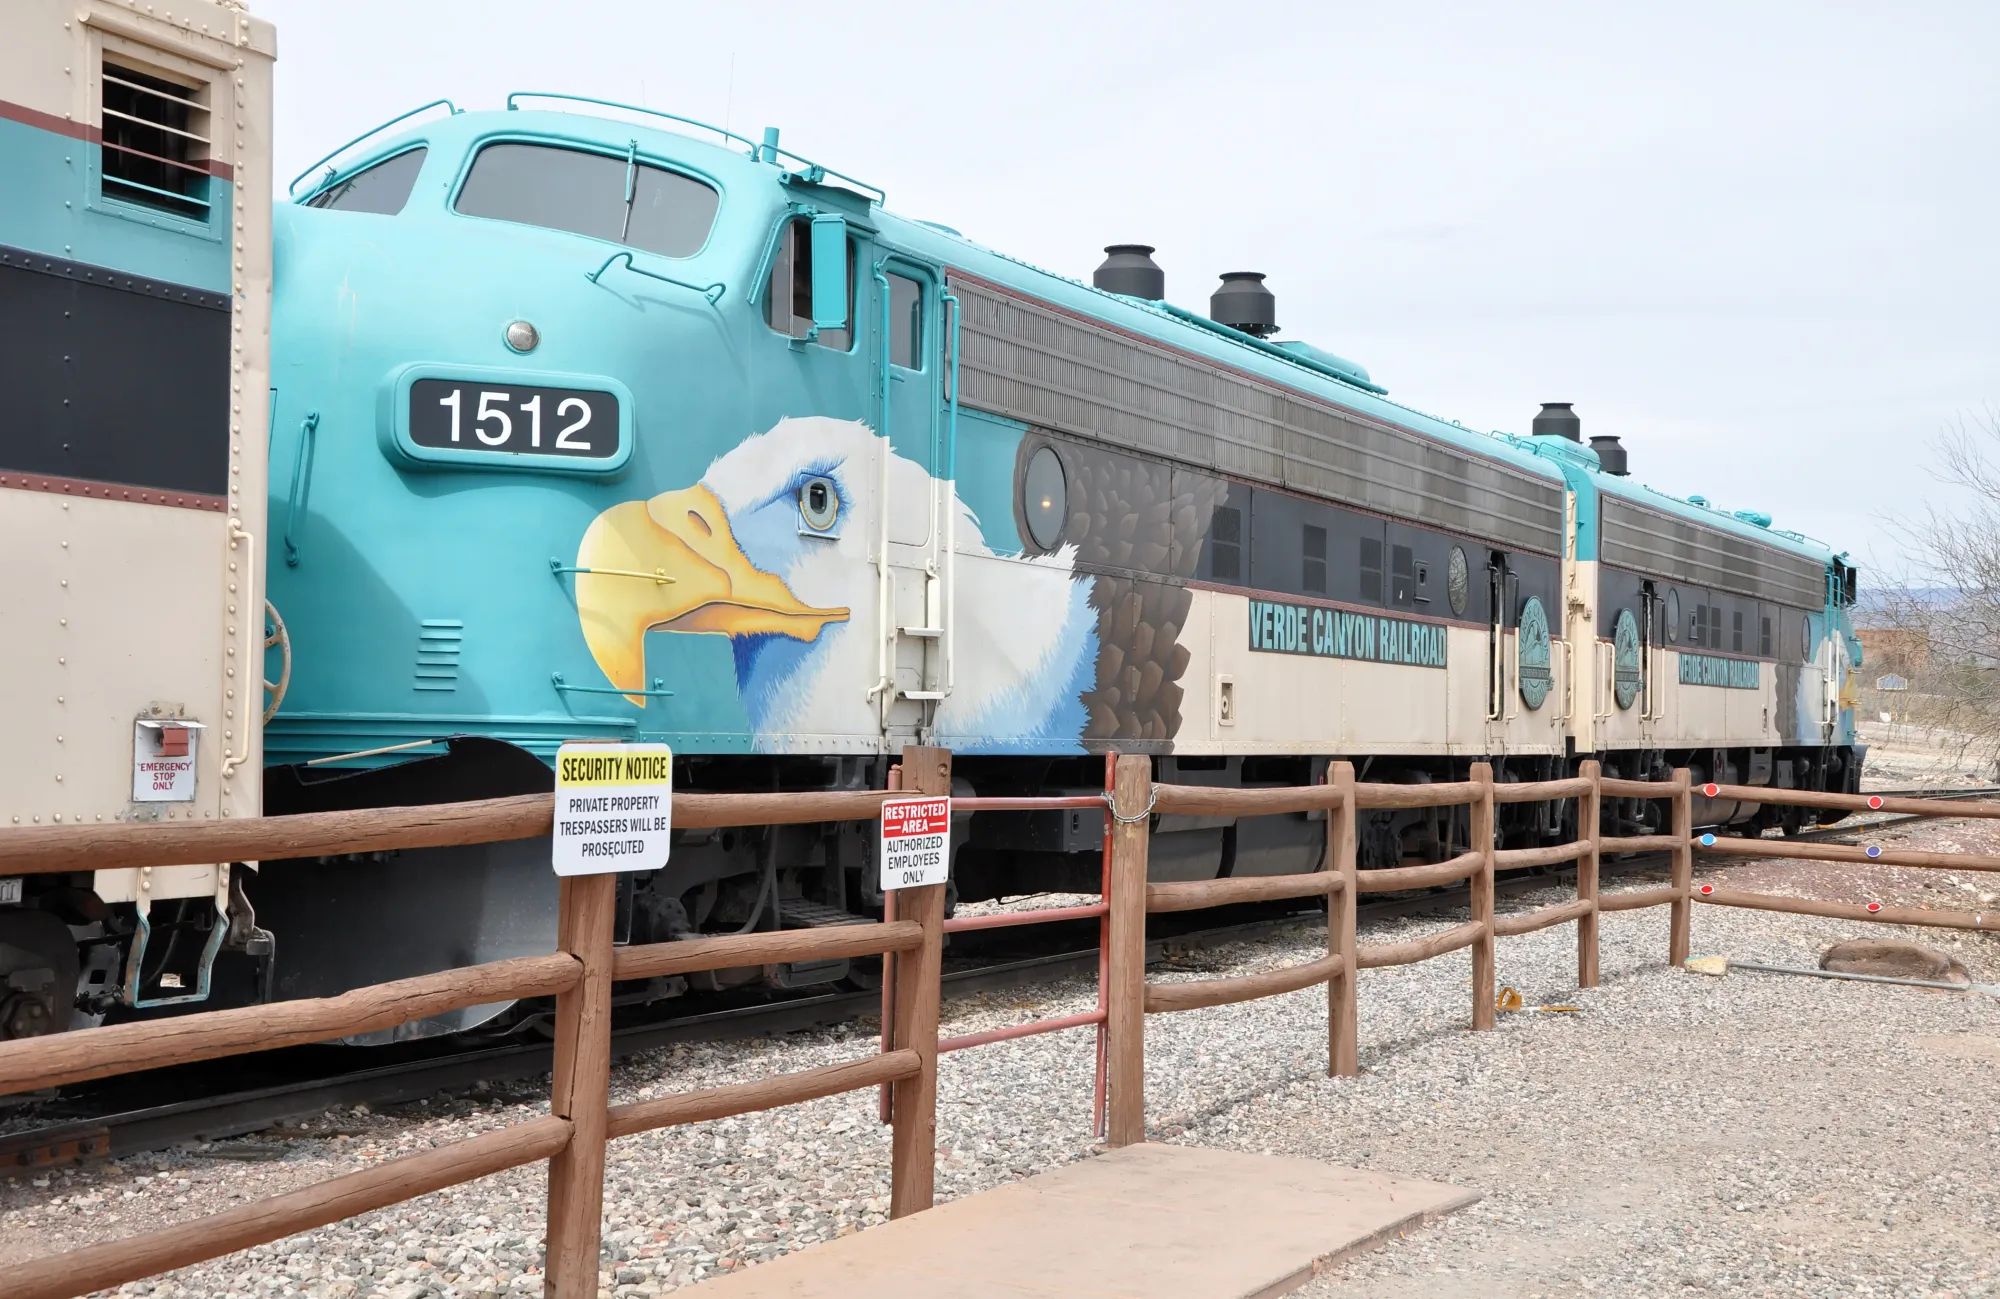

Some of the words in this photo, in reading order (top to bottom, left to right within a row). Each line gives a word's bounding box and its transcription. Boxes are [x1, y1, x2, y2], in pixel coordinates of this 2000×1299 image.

[440, 389, 592, 450] 1512
[1250, 601, 1307, 652] VERDE
[1312, 608, 1375, 659] CANYON
[1379, 619, 1447, 666] RAILROAD
[1679, 653, 1702, 684] VERDE
[1702, 656, 1729, 687] CANYON
[140, 762, 191, 772] EMERGENCY
[562, 757, 622, 782] SECURITY
[626, 756, 667, 780] NOTICE
[153, 772, 176, 781] STOP
[152, 781, 175, 791] ONLY
[569, 797, 609, 813] PRIVATE
[611, 796, 659, 811] PROPERTY
[885, 803, 946, 820] RESTRICTED
[560, 818, 628, 836] TRESPASSERS
[630, 817, 652, 833] WILL
[654, 817, 666, 831] BE
[902, 819, 929, 834] AREA
[582, 840, 644, 857] PROSECUTED
[886, 836, 943, 853] AUTHORIZED
[888, 852, 940, 870] EMPLOYEES
[903, 870, 925, 884] ONLY
